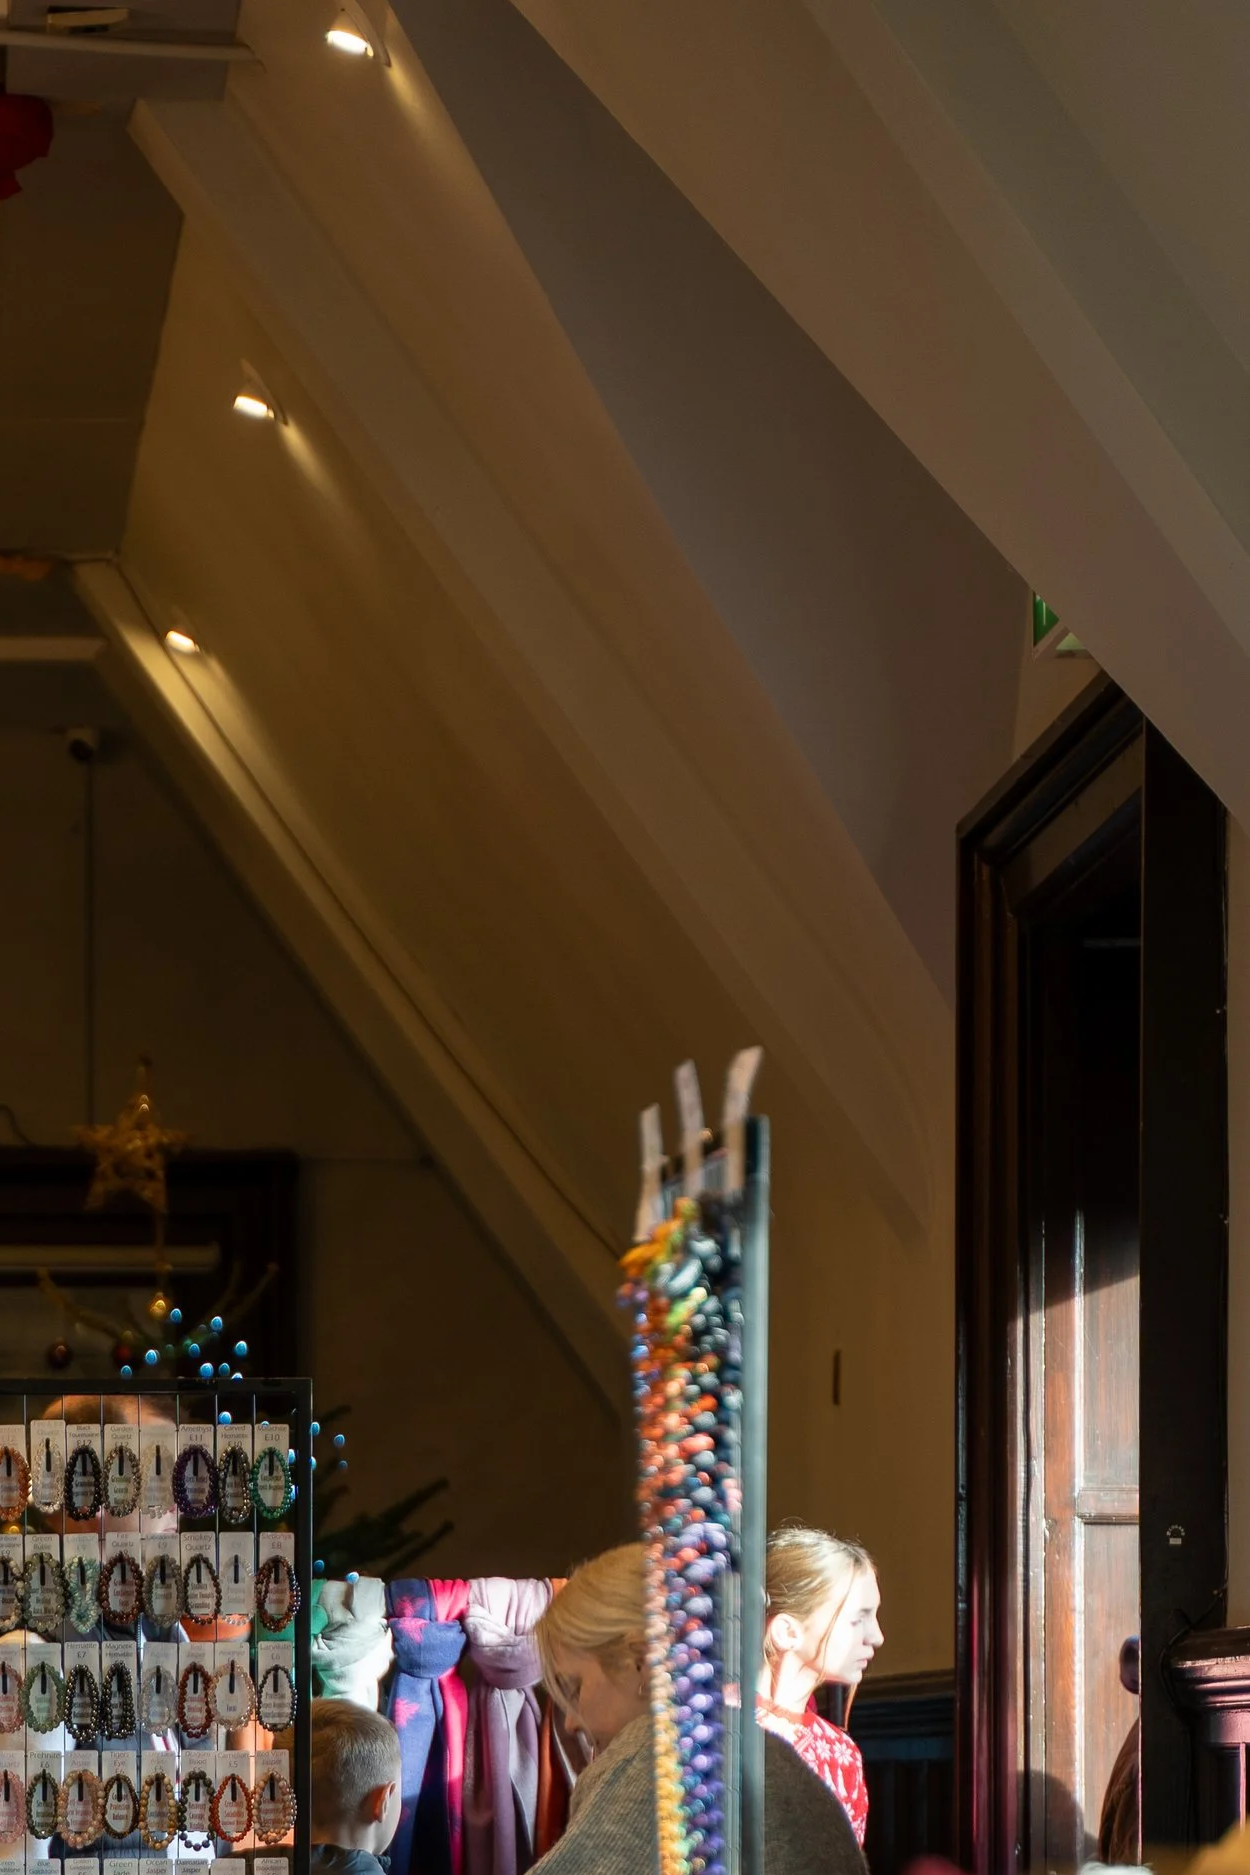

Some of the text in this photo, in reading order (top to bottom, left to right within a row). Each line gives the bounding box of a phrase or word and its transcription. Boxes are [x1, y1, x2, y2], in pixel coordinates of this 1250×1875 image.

[181, 1425, 212, 1433] Amethyst
[183, 1534, 213, 1542] Smokey
[185, 1543, 211, 1551] Quartz
[113, 1759, 126, 1767] Eye
